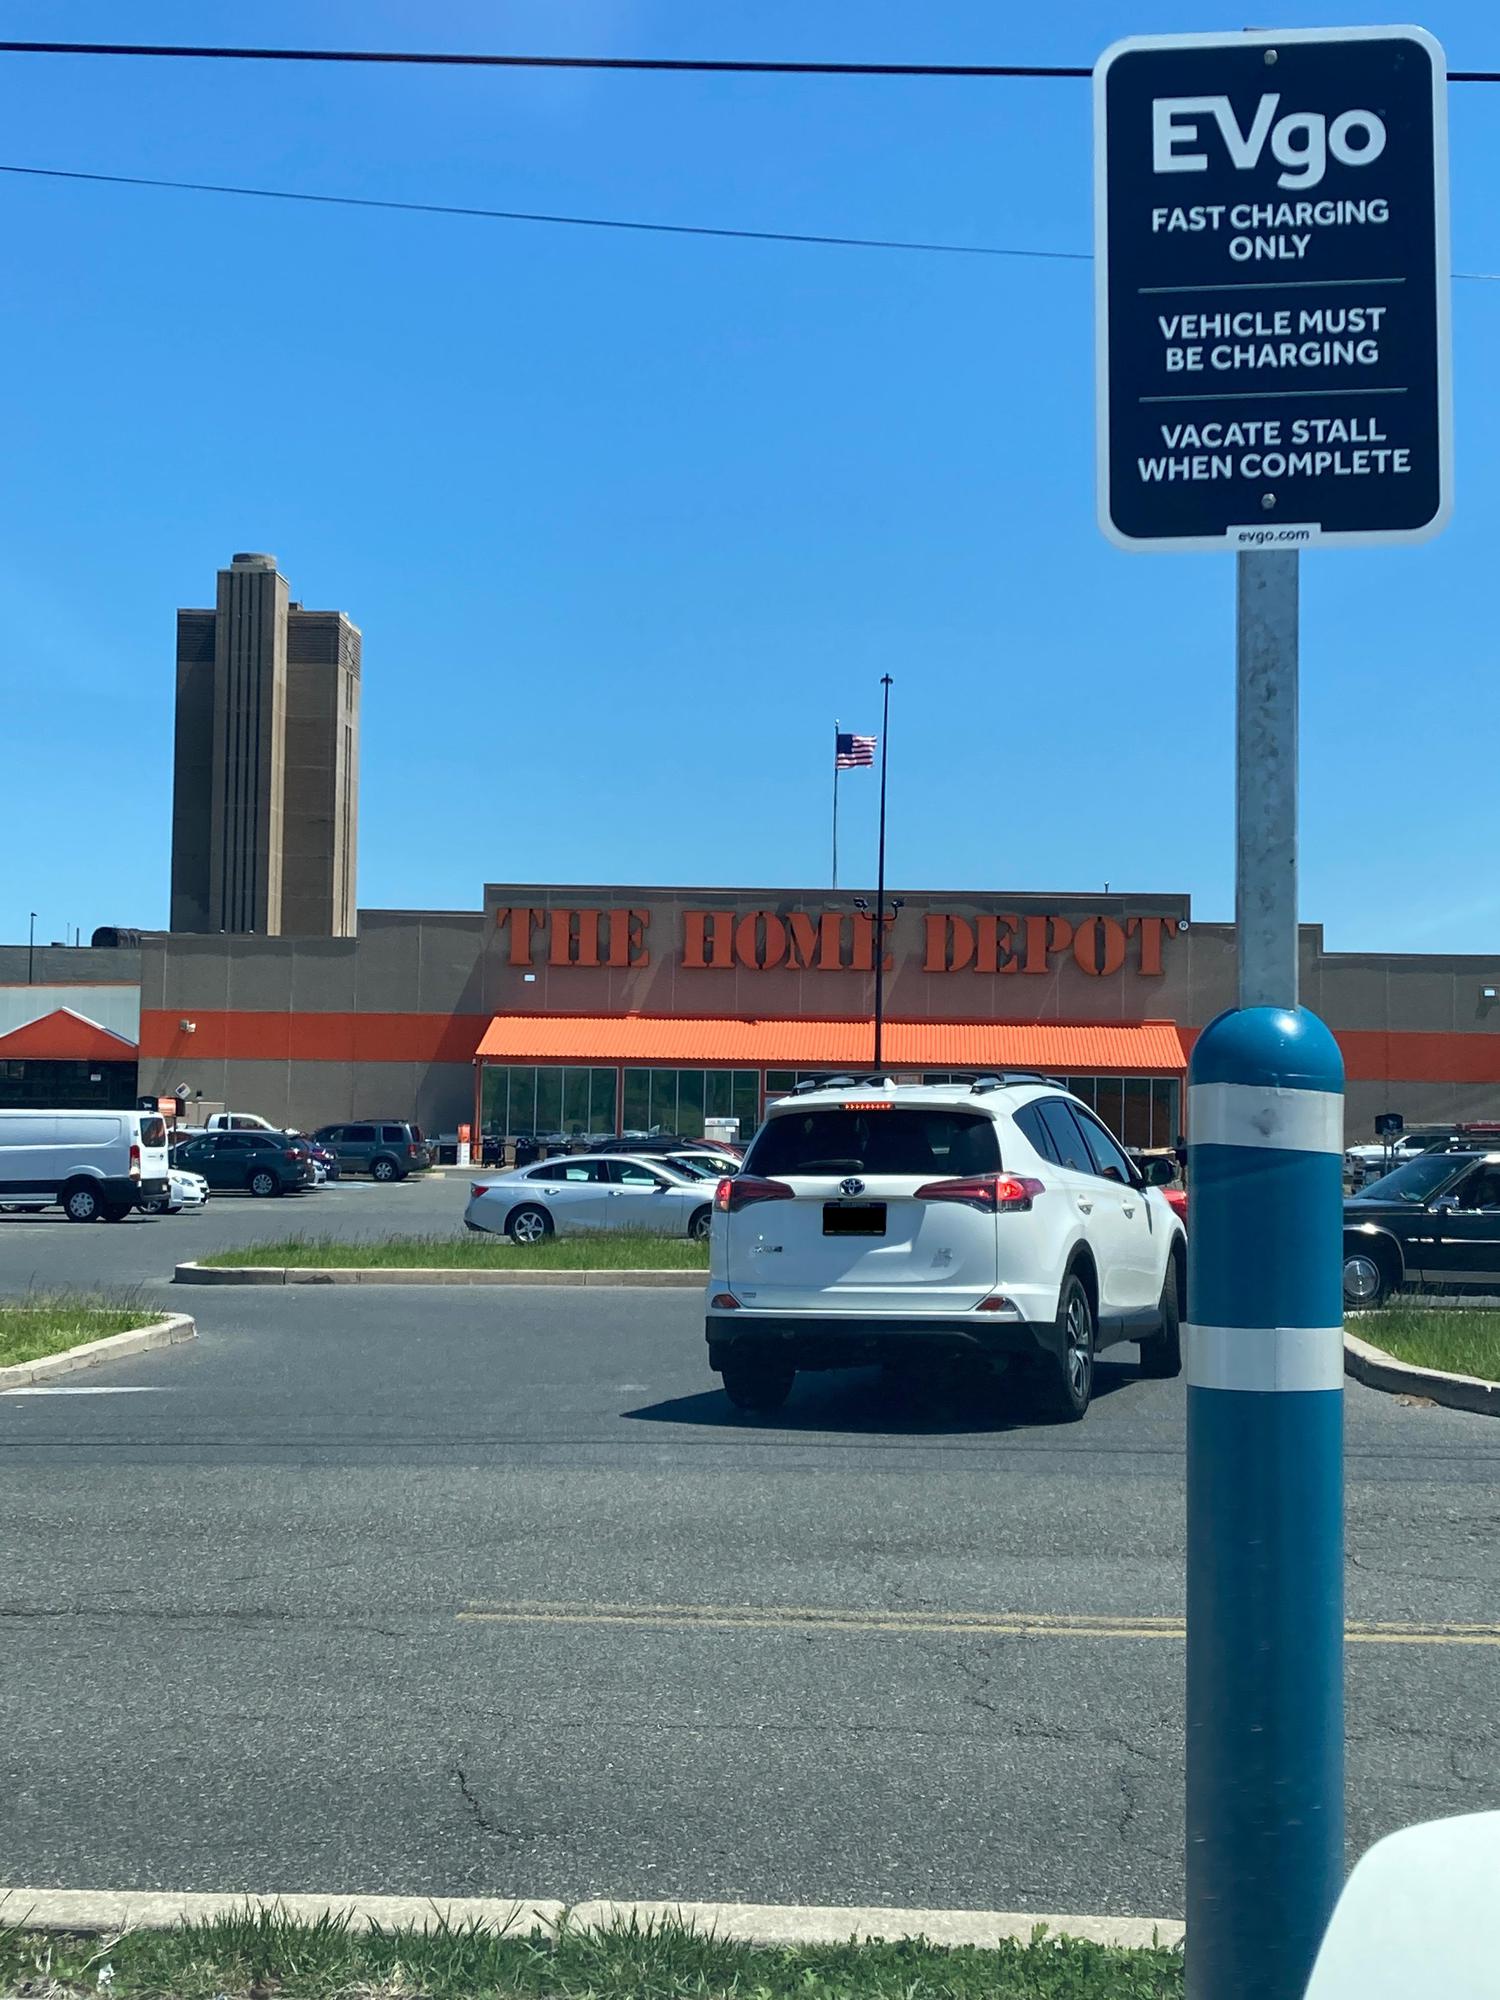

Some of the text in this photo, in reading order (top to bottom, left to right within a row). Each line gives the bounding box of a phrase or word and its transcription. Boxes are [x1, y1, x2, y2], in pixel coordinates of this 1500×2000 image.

[1152, 93, 1387, 189] EVgo
[1152, 199, 1389, 232] FAST CHARGING
[1229, 234, 1312, 261] ONLY
[1158, 307, 1387, 340] VEHICLE MUST
[1166, 340, 1379, 372] BE CHARGING
[1161, 417, 1387, 449] VACATE STALL
[1137, 448, 1412, 482] WHEN COMPLETE
[1238, 530, 1310, 544] evgo.com
[496, 907, 1177, 976] THE HOME DEPOT
